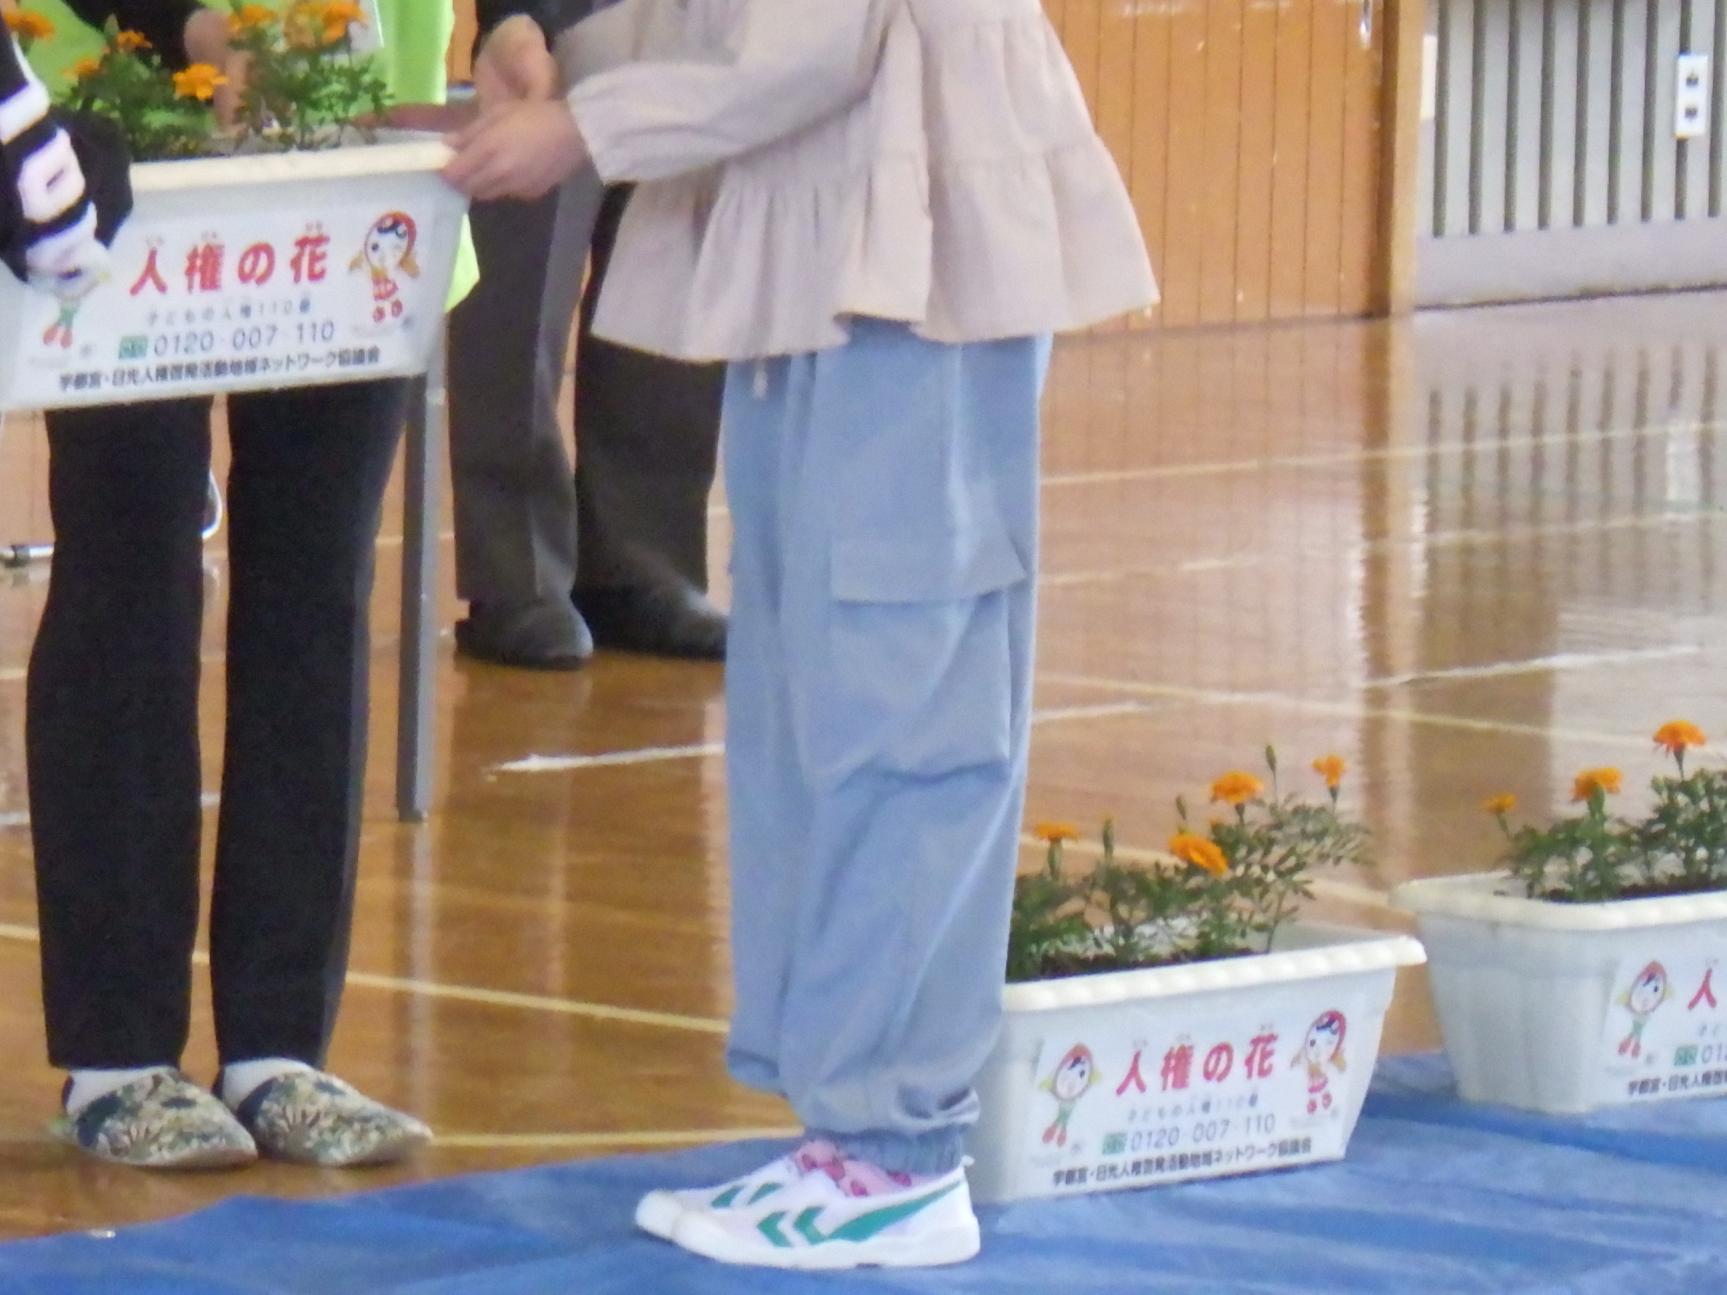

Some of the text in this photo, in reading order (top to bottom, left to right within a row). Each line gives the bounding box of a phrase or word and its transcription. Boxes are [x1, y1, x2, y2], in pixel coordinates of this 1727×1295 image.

[129, 233, 331, 296] 人権の花
[1116, 1033, 1279, 1095] 人権の花
